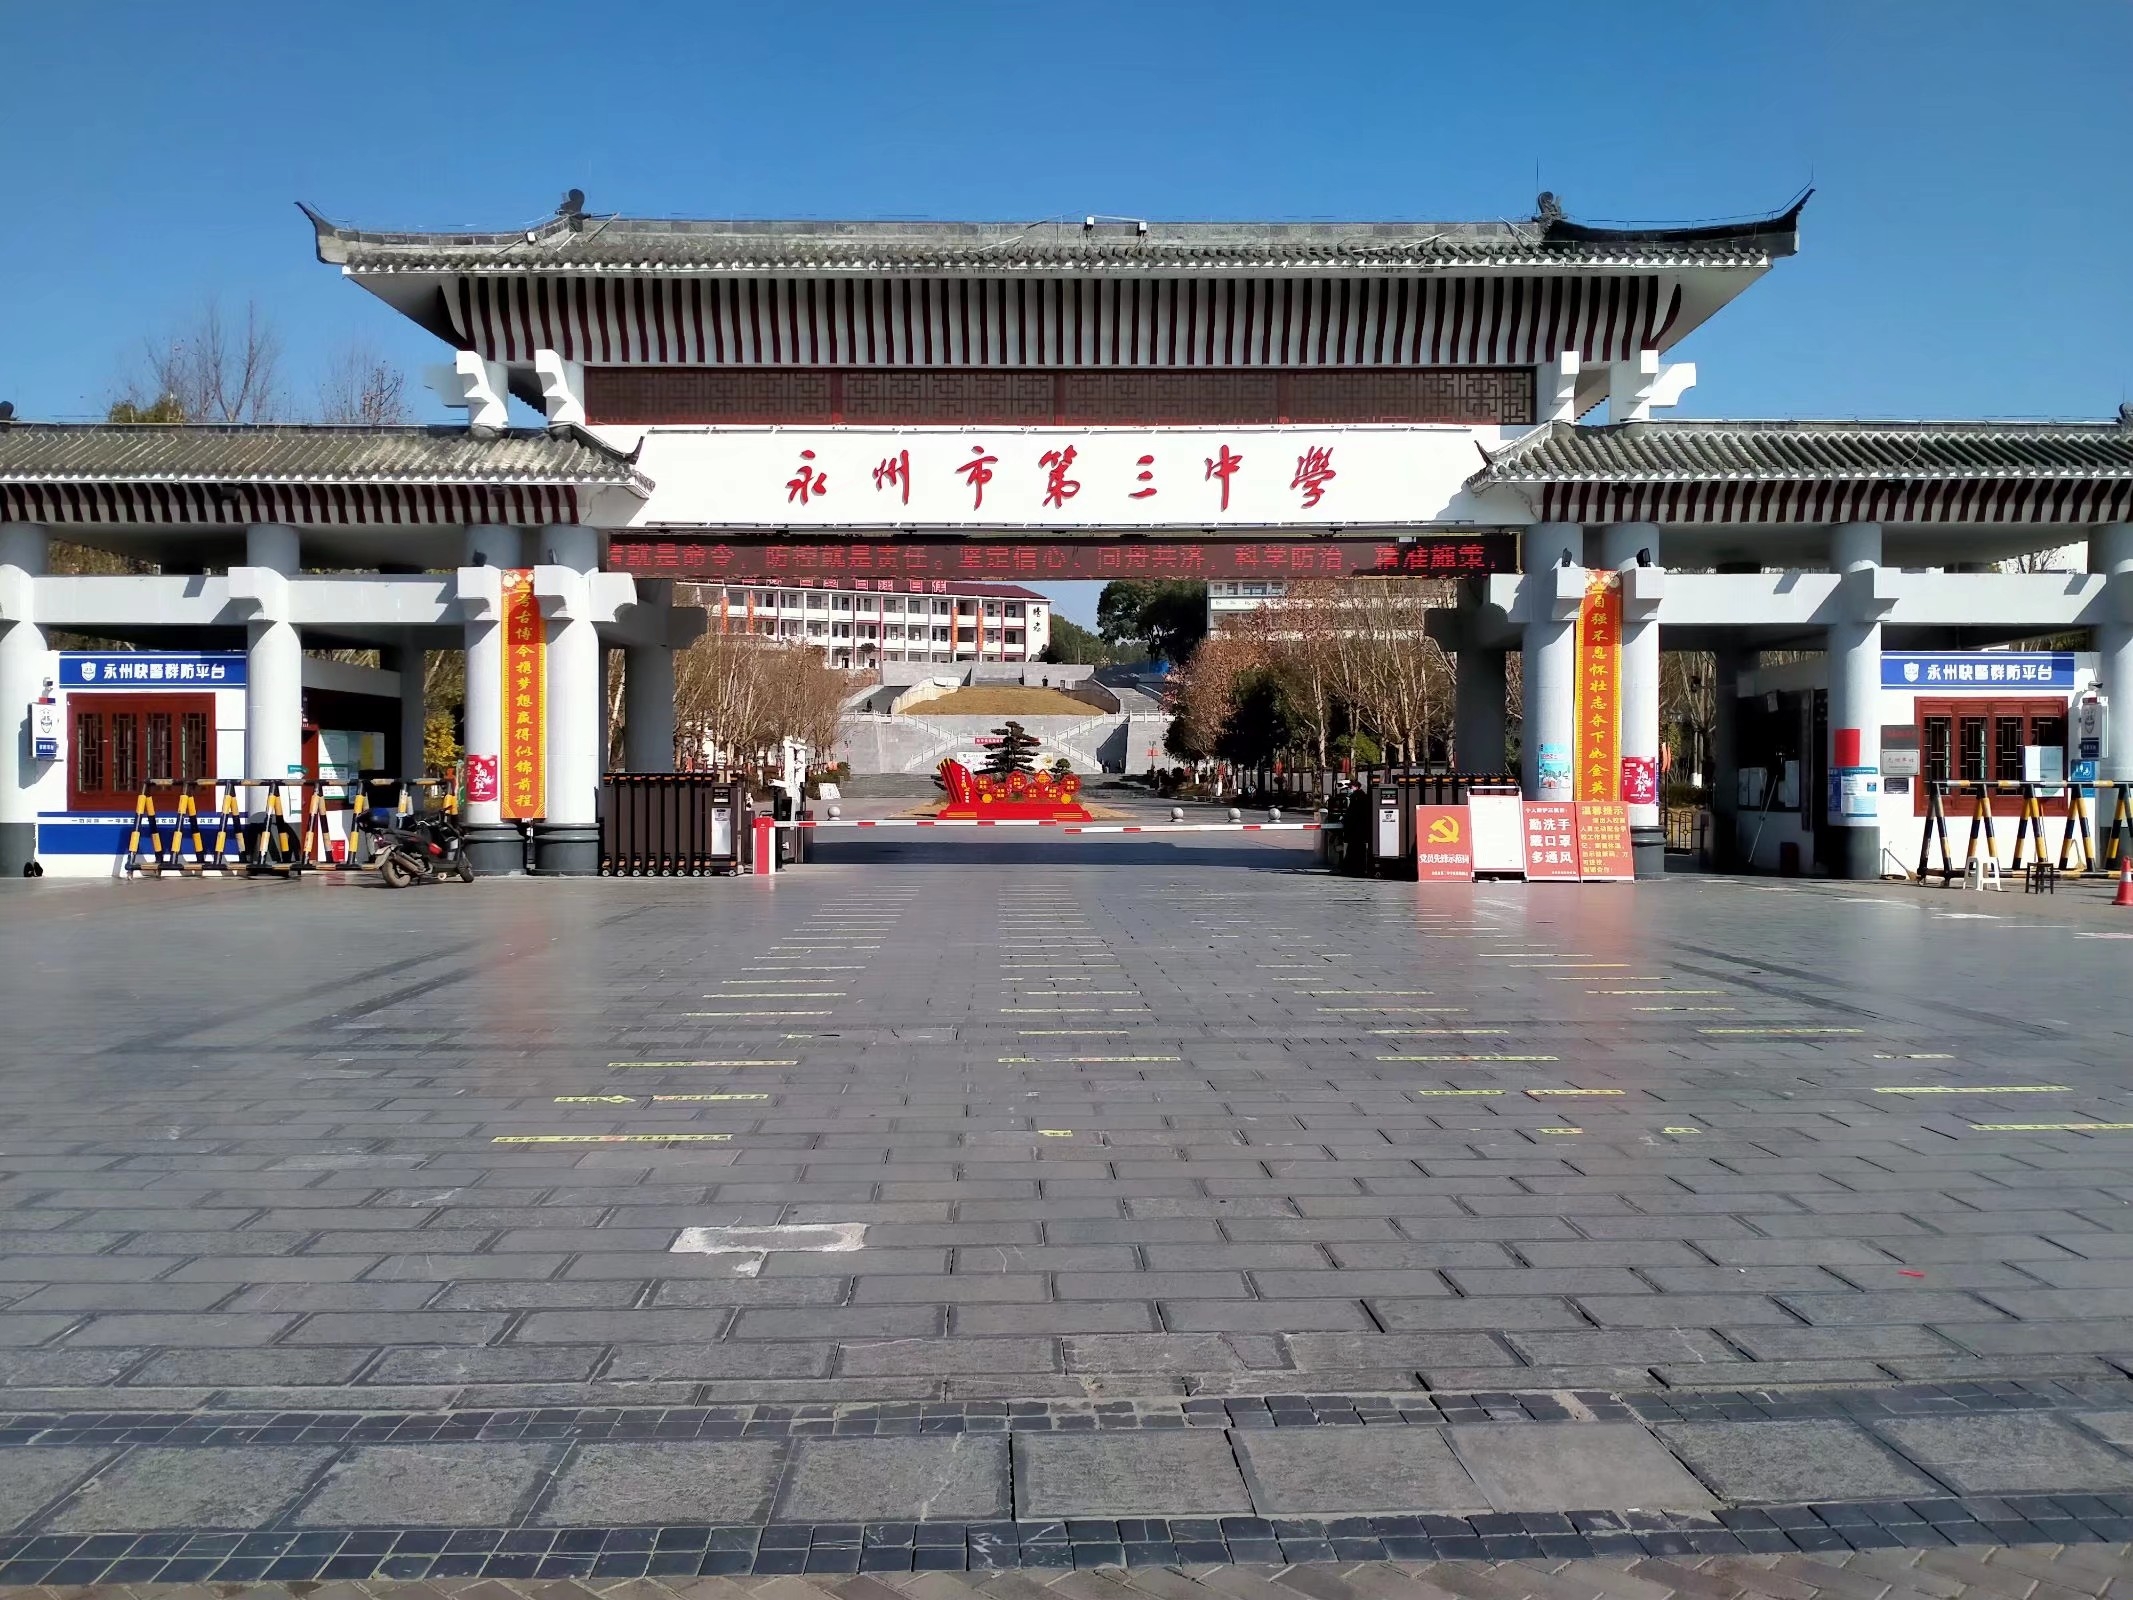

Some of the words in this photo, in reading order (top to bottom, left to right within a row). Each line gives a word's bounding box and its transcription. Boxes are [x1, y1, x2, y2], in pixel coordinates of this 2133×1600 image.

[785, 444, 1337, 511] 永州市第三中學
[103, 663, 225, 680] 永州快警群防平台
[1927, 664, 2053, 681] 永州快警群防平台
[1529, 818, 1571, 831] 勤洗手
[1529, 834, 1572, 847] 戴口罩
[1531, 851, 1574, 864] 多通风
